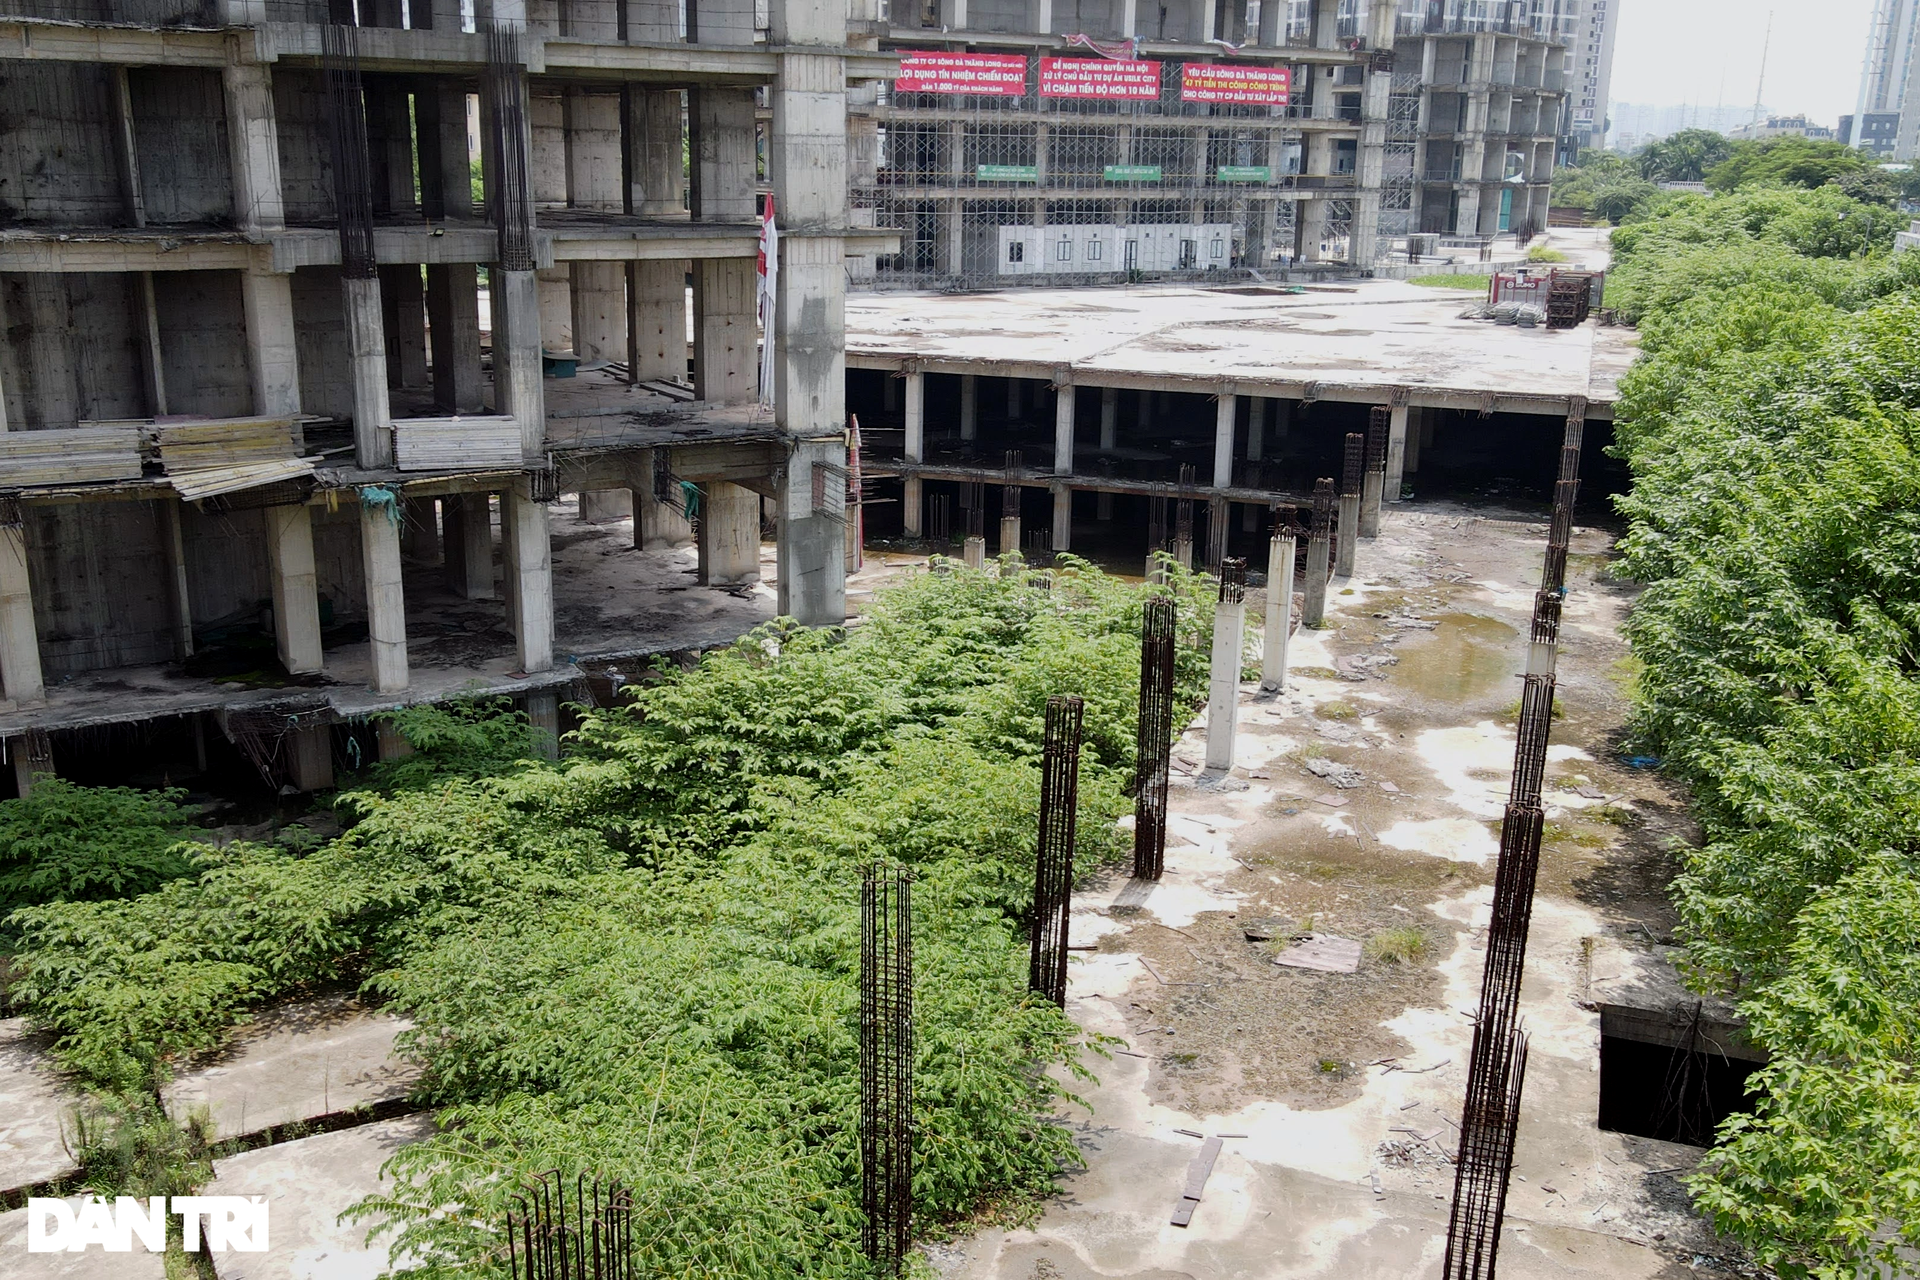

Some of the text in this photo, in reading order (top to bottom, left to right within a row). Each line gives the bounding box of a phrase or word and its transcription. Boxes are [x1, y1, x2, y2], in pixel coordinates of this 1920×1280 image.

[964, 59, 984, 67] THĂNG
[1052, 59, 1148, 74] ĐỀ NGHỊ CHÍNH QUYỀN HÀ NỘI
[900, 69, 1023, 84] LỢI DỤNG TÍN NHIỆM CHIẾM ĐOẠT
[1043, 71, 1053, 79] XỬ
[1054, 71, 1062, 79] LÝ
[1063, 71, 1077, 80] CHỦ
[1079, 71, 1092, 80] ĐẦU
[1103, 74, 1112, 83] DỰ
[1113, 73, 1122, 81] ÁN
[1201, 67, 1215, 77] CẦU
[1216, 69, 1234, 78] SÔNG
[1246, 71, 1267, 80] THĂNG
[1268, 73, 1285, 81] LONG
[1043, 82, 1156, 96] VÌ CHẬM TIẾN ĐỘ HƠN 10 NĂM
[1203, 78, 1216, 88] TIỀN
[1229, 80, 1248, 89] CÔNG
[1249, 82, 1268, 90] CÔNG
[1269, 82, 1286, 91] TRÌNH
[1198, 90, 1216, 98] CÔNG
[1234, 90, 1246, 100] ĐẦU
[1254, 92, 1266, 101] XÂY
[1266, 92, 1277, 101] LẮP
